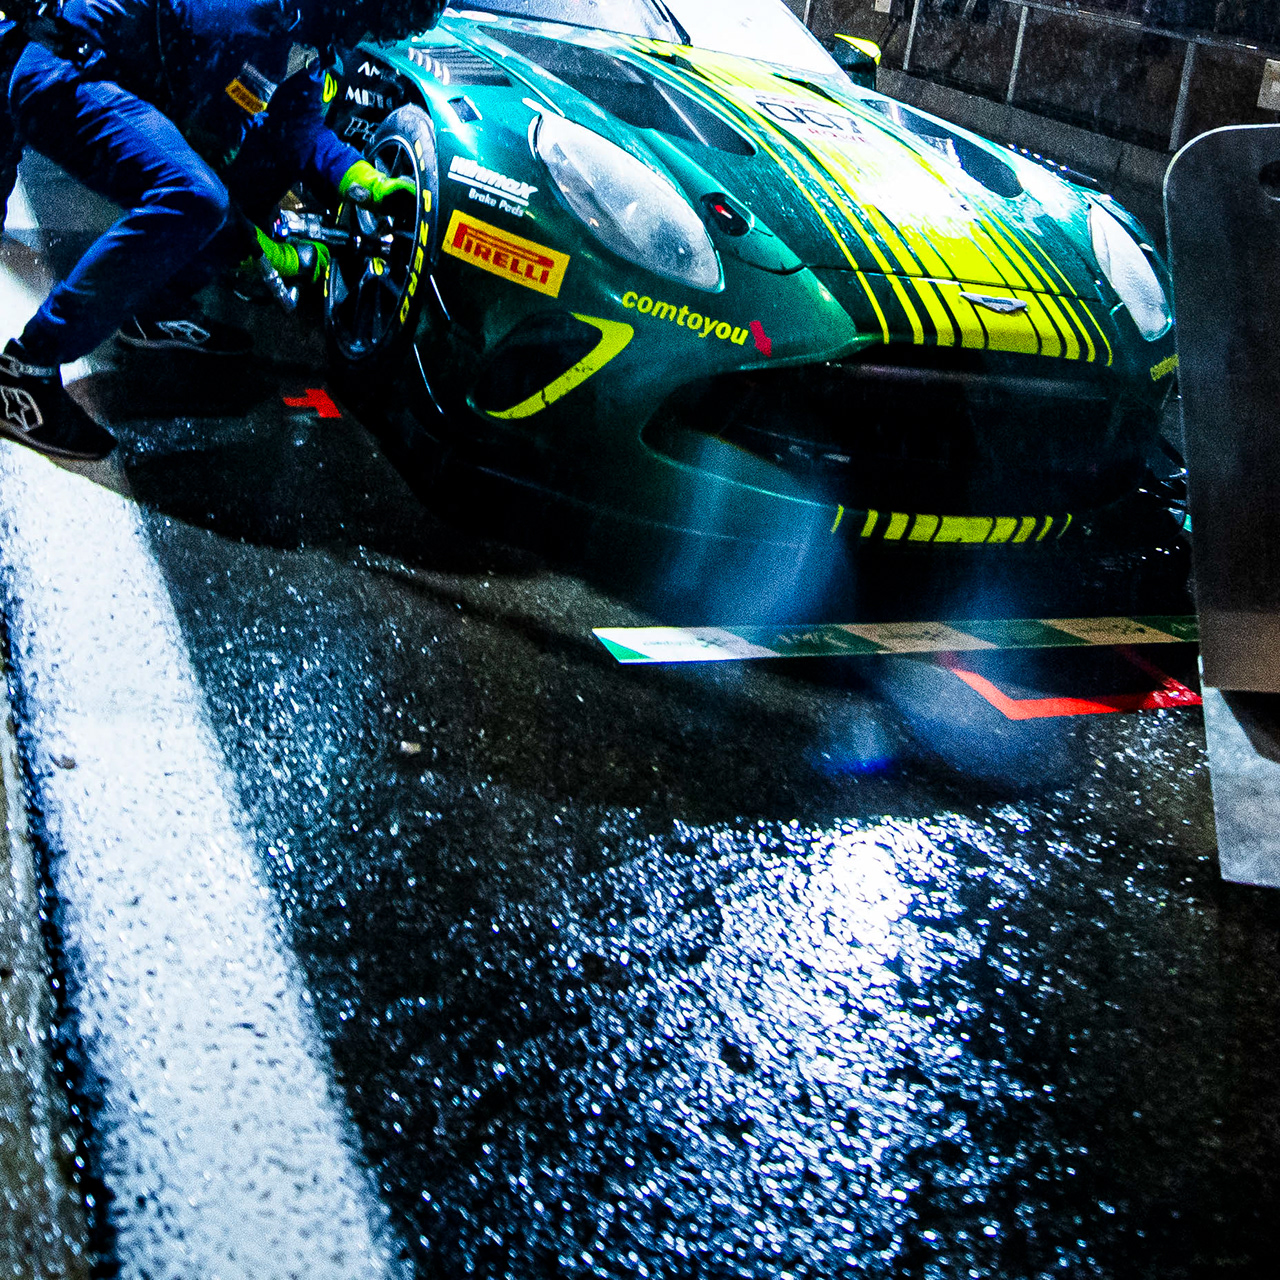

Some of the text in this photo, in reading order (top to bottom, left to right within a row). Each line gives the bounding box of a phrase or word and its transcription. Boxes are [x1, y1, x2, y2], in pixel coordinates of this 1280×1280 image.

[468, 187, 524, 218] Brake Pads
[452, 221, 555, 285] PIRELLI
[621, 290, 749, 346] comtoyou
